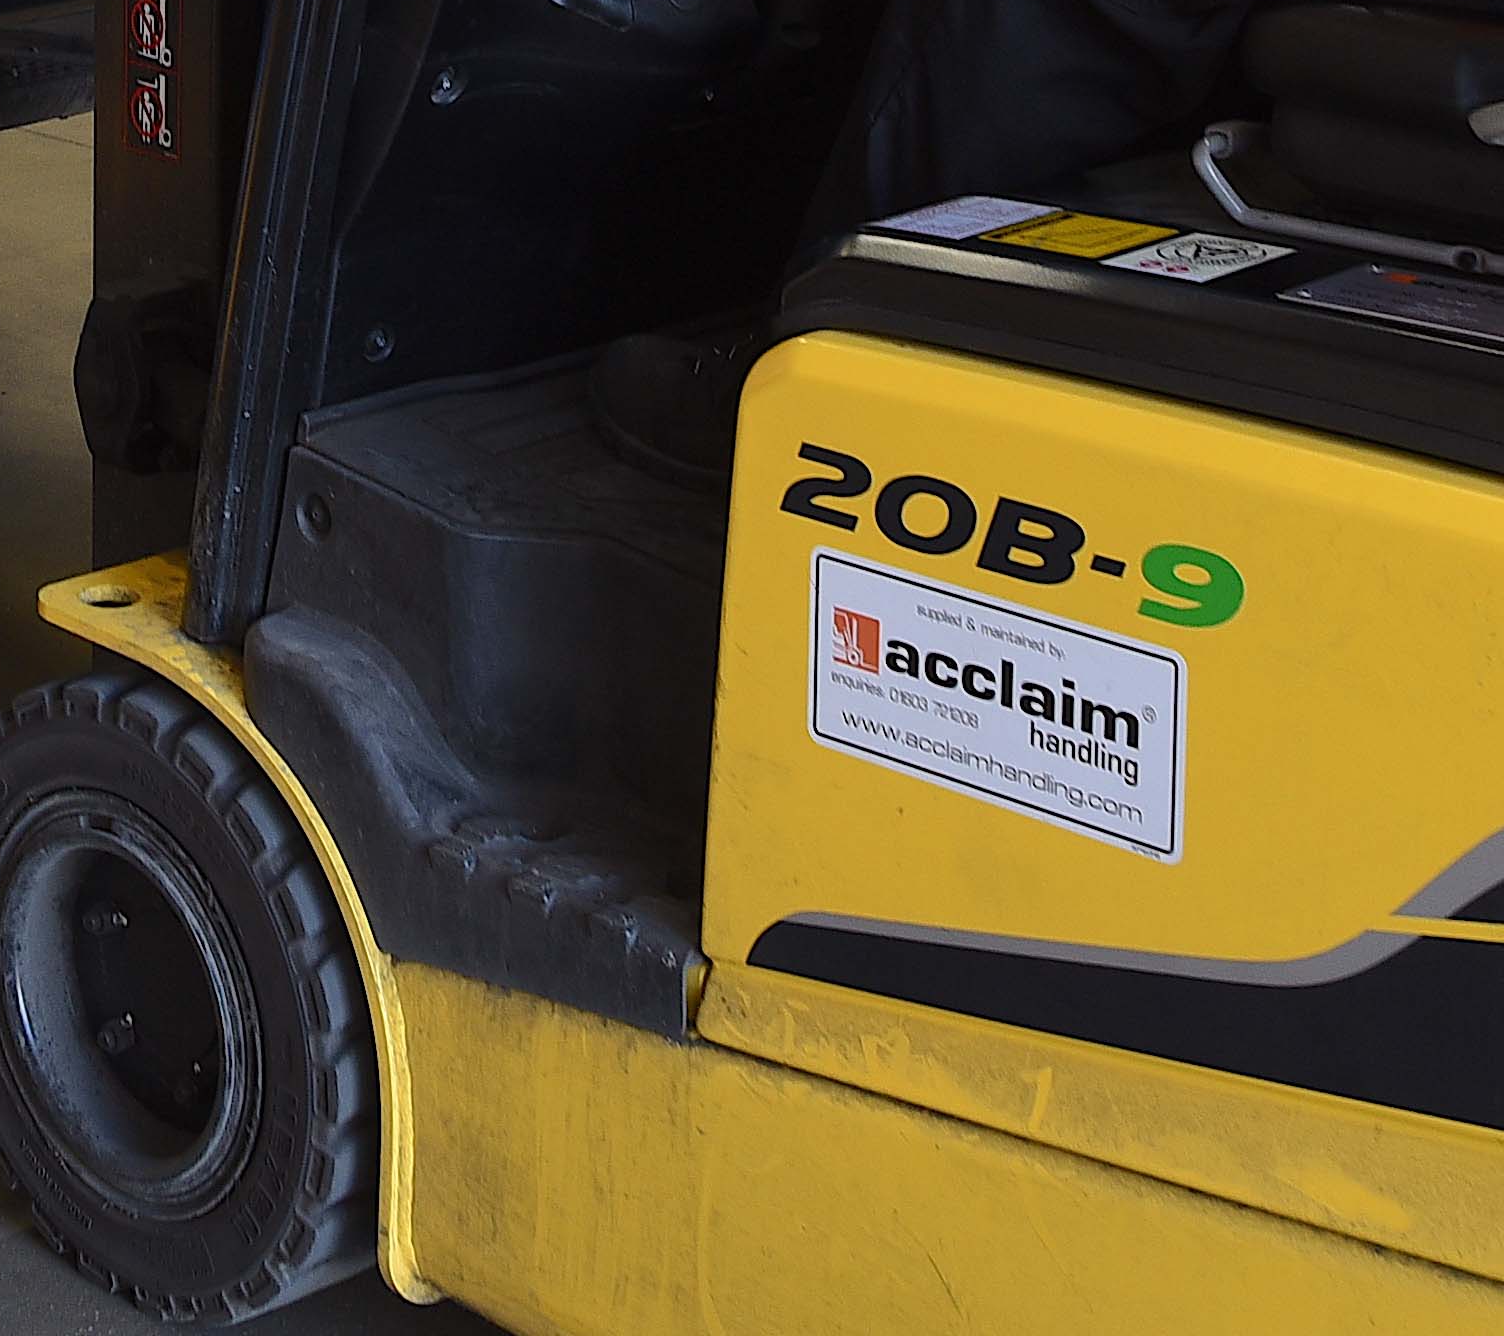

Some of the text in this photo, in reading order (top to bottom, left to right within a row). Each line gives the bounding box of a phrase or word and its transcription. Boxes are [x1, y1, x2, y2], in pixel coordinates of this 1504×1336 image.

[779, 441, 1245, 629] 20B-9
[966, 616, 976, 631] &
[885, 638, 1140, 749] acclaim
[841, 710, 1143, 825] www.acclaimhandling.com
[1029, 721, 1140, 787] handling
